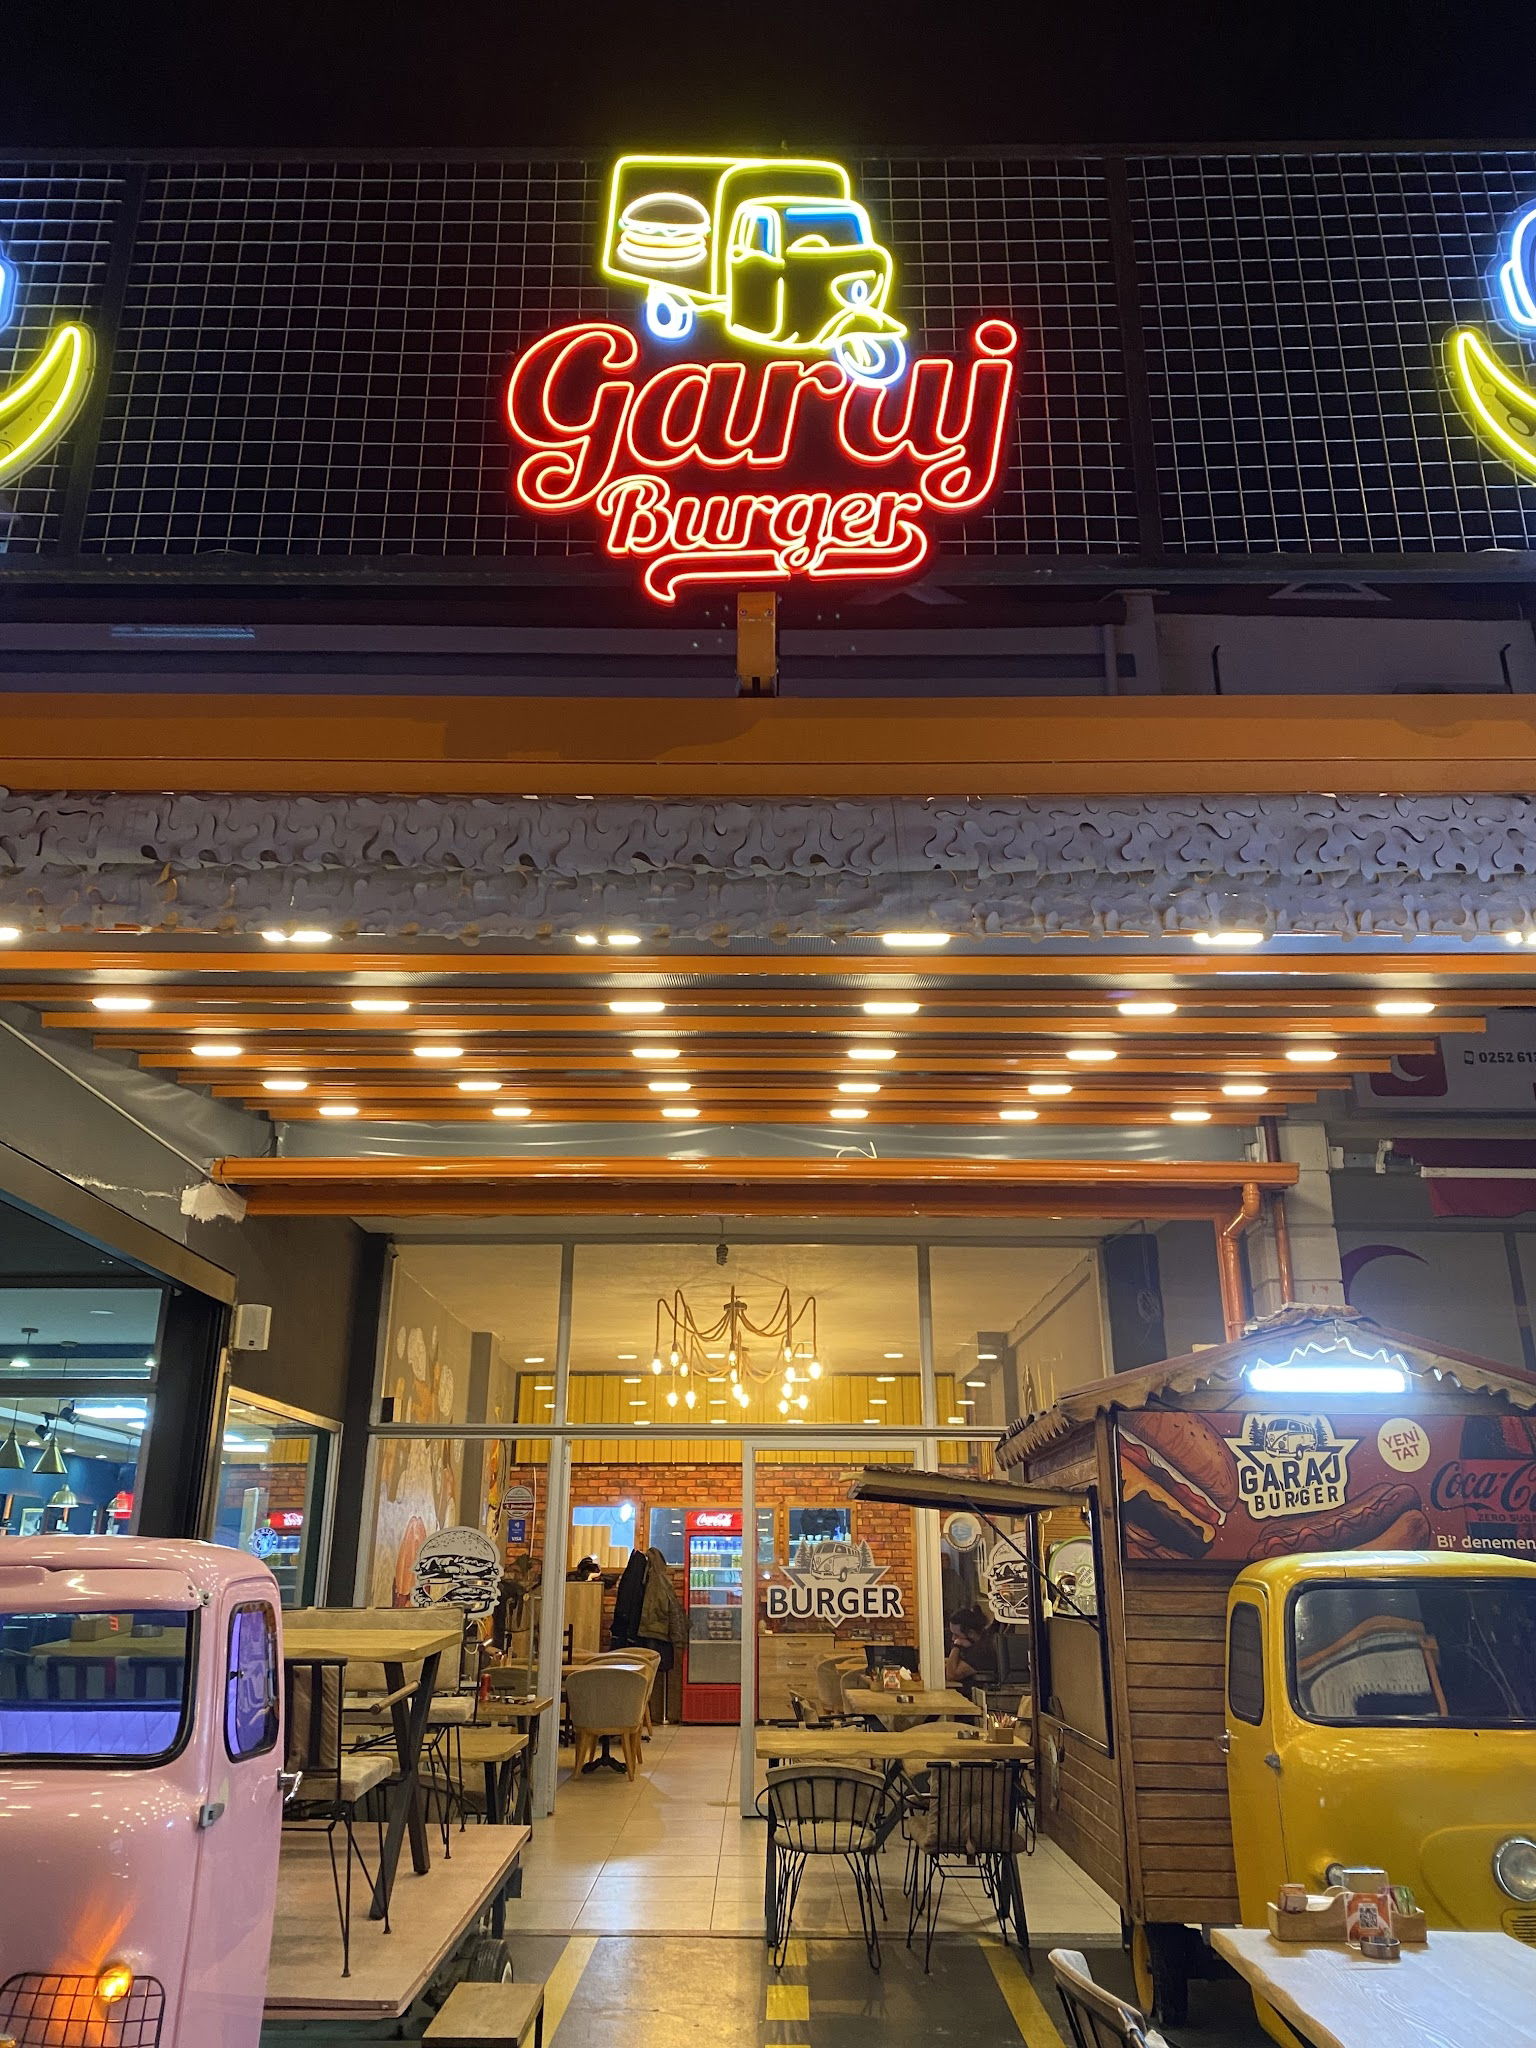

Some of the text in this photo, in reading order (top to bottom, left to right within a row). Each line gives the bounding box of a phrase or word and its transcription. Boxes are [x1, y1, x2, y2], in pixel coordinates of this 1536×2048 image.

[597, 474, 926, 576] Burger
[1478, 1051, 1514, 1064] 0252
[1382, 1426, 1420, 1449] YENİ
[1391, 1444, 1421, 1461] TAT
[1240, 1453, 1341, 1495] GARAJ
[1254, 1485, 1339, 1512] BURGER
[1478, 1513, 1506, 1522] ZERO
[769, 1587, 903, 1615] BURGER
